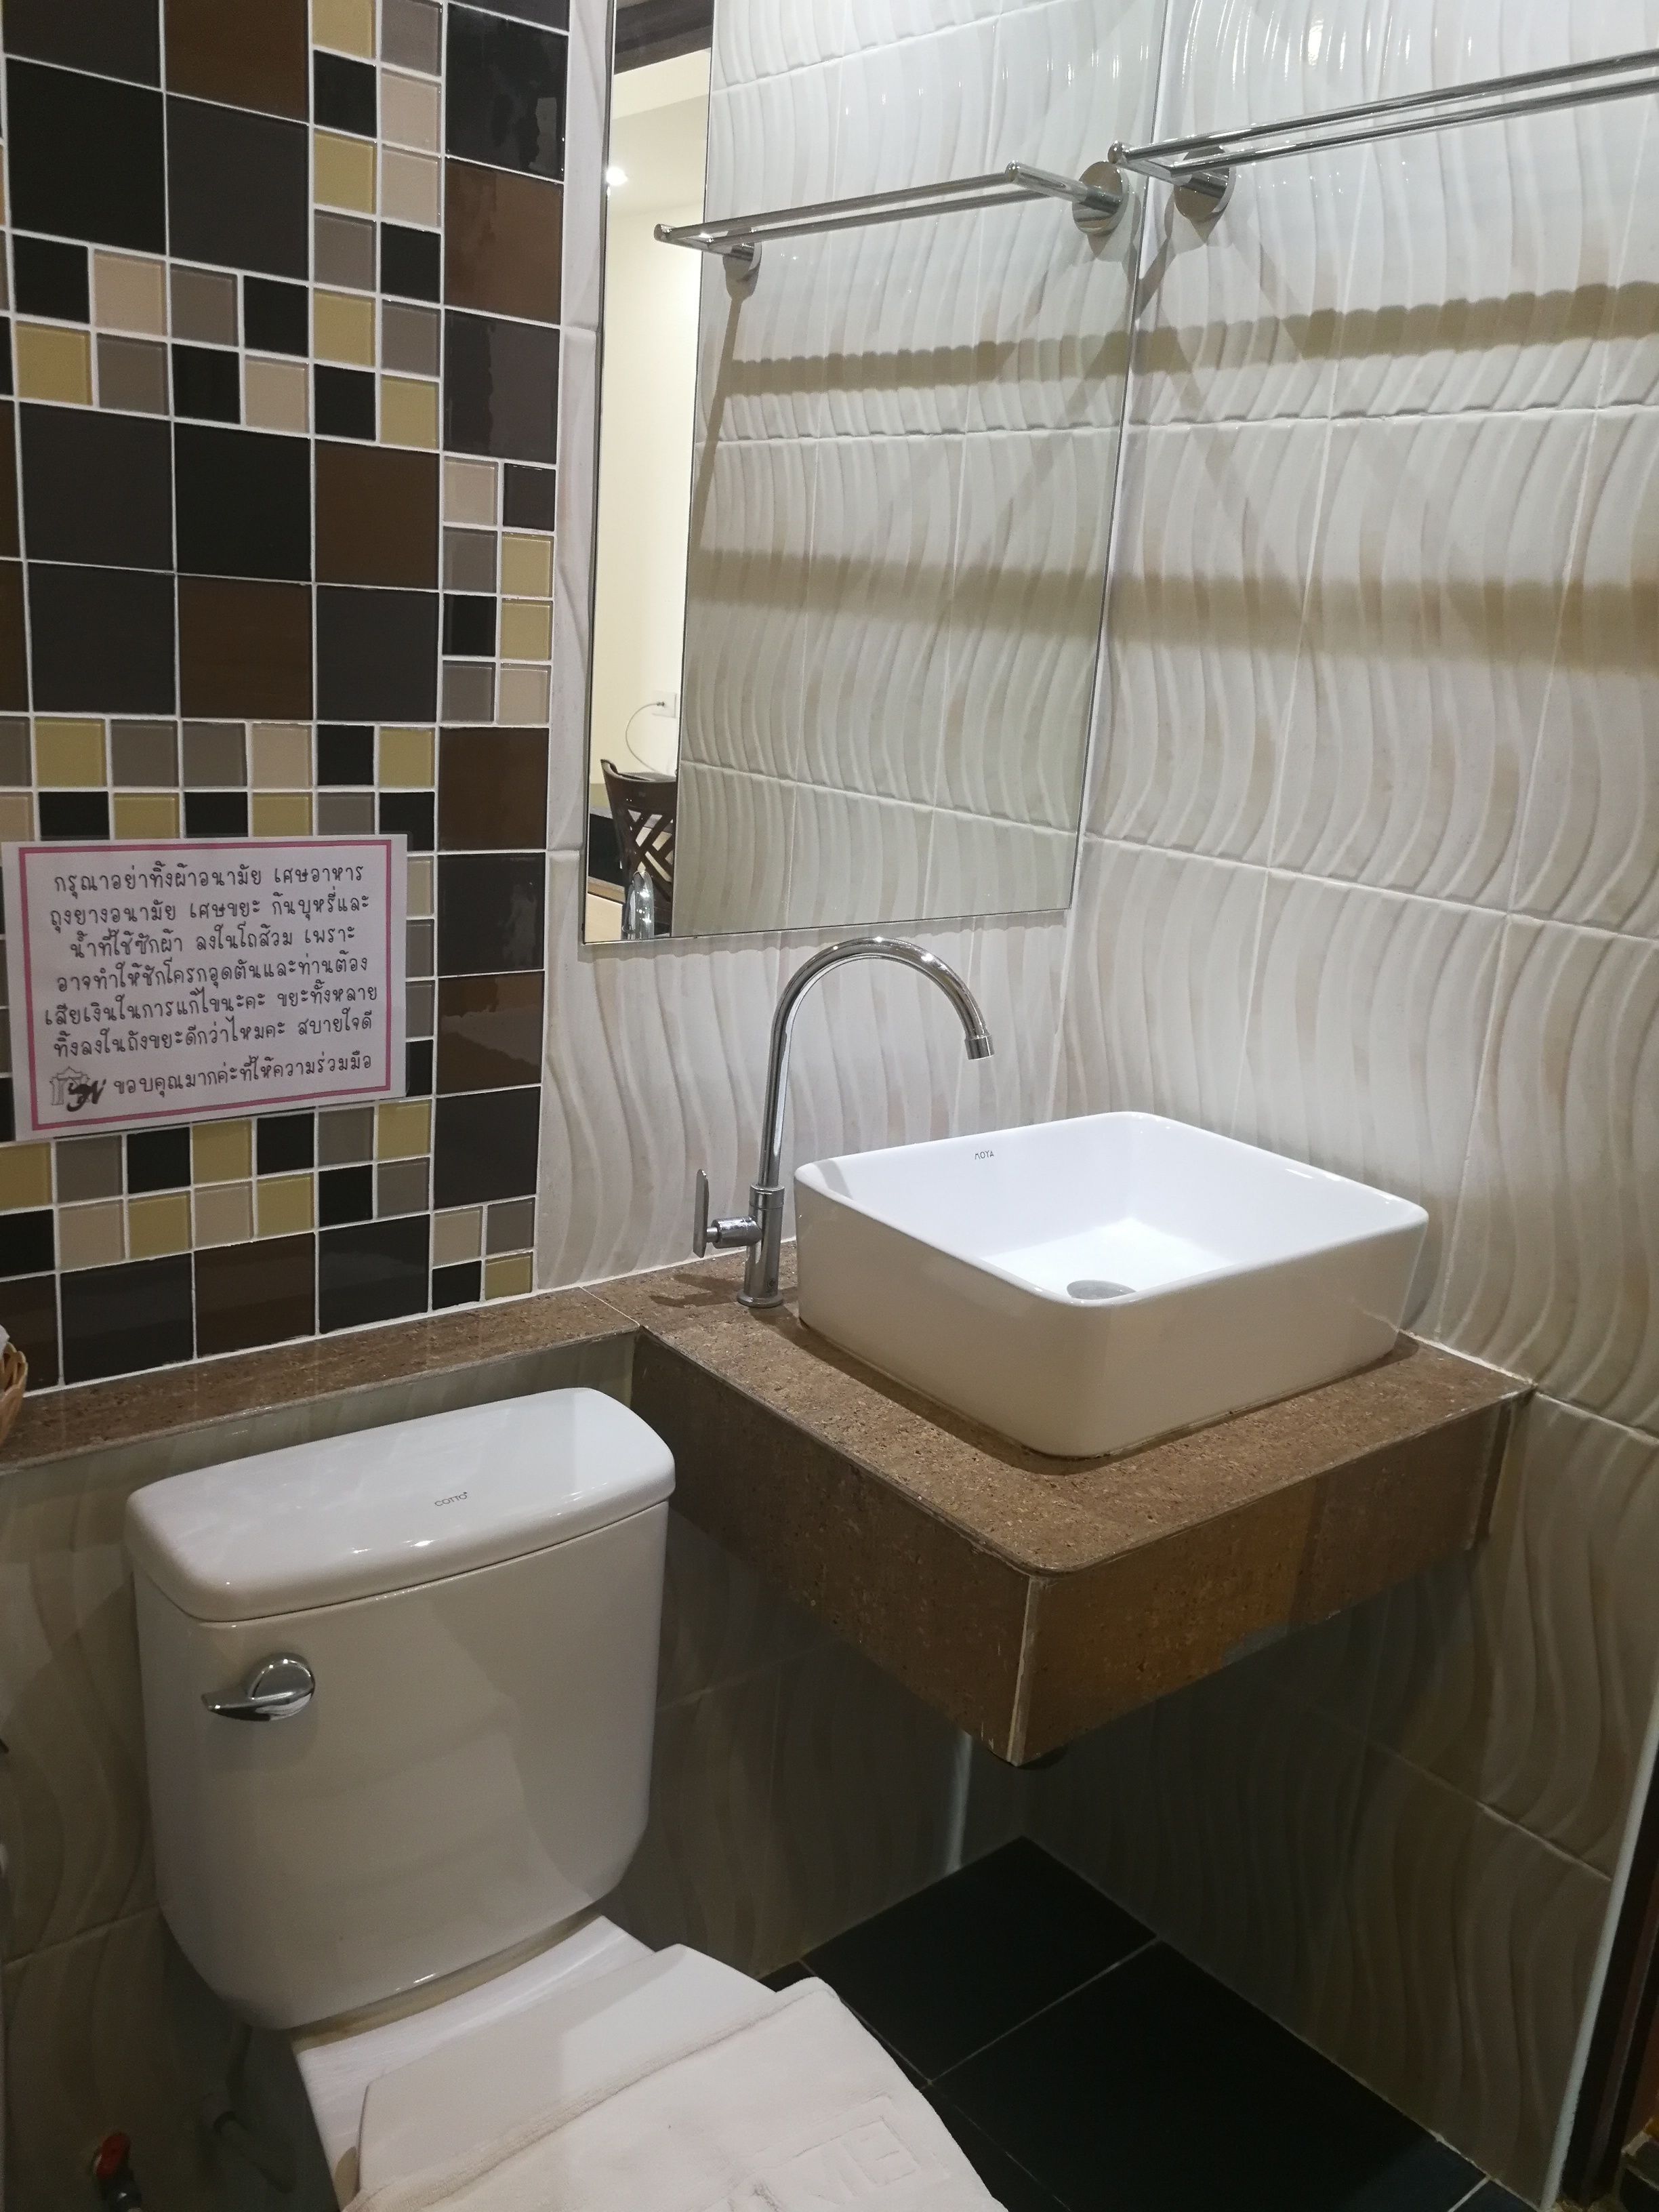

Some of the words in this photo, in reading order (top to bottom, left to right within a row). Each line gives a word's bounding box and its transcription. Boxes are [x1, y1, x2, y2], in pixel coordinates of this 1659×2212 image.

[55, 860, 261, 899] กรุณาอย่าทิ้งผ้าอนามัย
[274, 865, 364, 884] เศษอาหาร
[50, 899, 176, 933] ถุงยางอนามัย
[190, 899, 260, 919] เศษขยะ
[196, 921, 293, 950] ลงในโถส้วม
[304, 926, 355, 943] เพราะ
[277, 979, 377, 1006] ขยะทั้งหลาย
[298, 1007, 373, 1036] สบายใจดี
